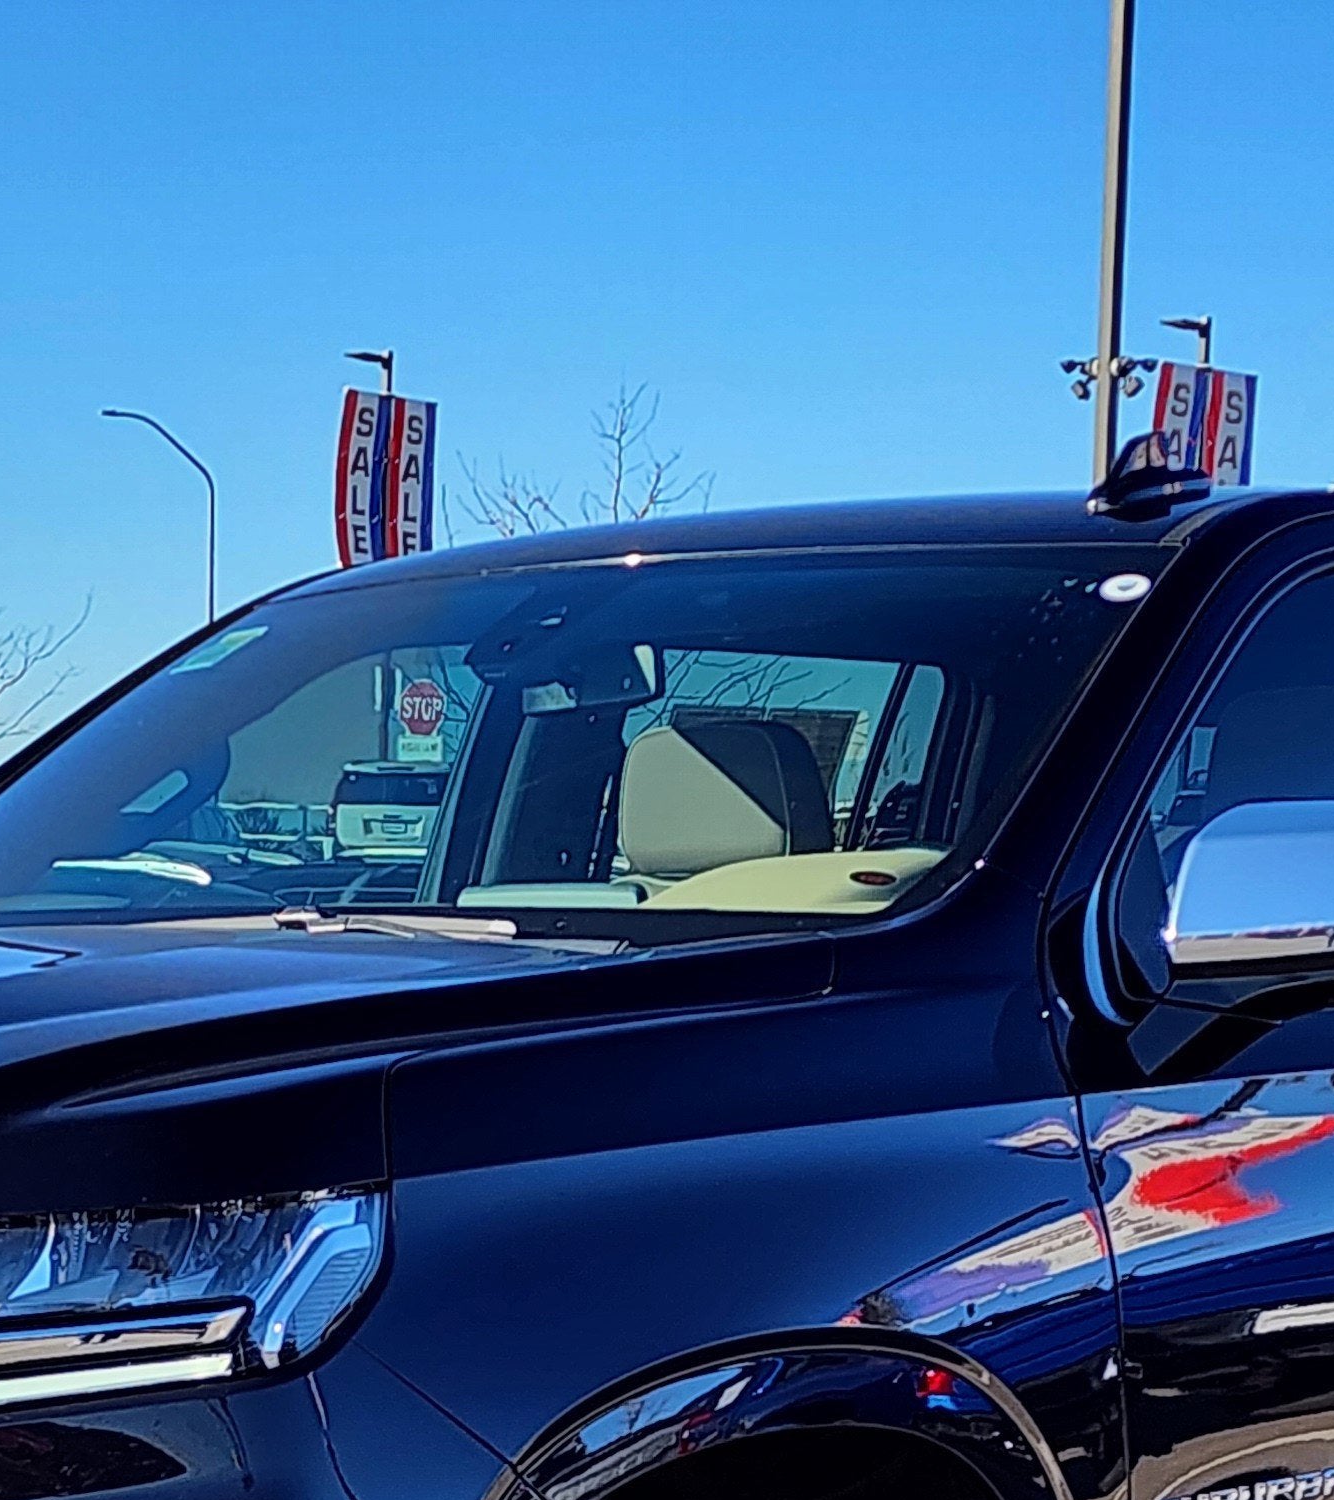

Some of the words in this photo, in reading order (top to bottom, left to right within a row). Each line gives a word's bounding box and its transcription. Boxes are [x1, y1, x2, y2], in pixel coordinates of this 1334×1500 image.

[350, 406, 375, 554] SALE
[1217, 390, 1243, 486] SA
[402, 696, 444, 721] STOP
